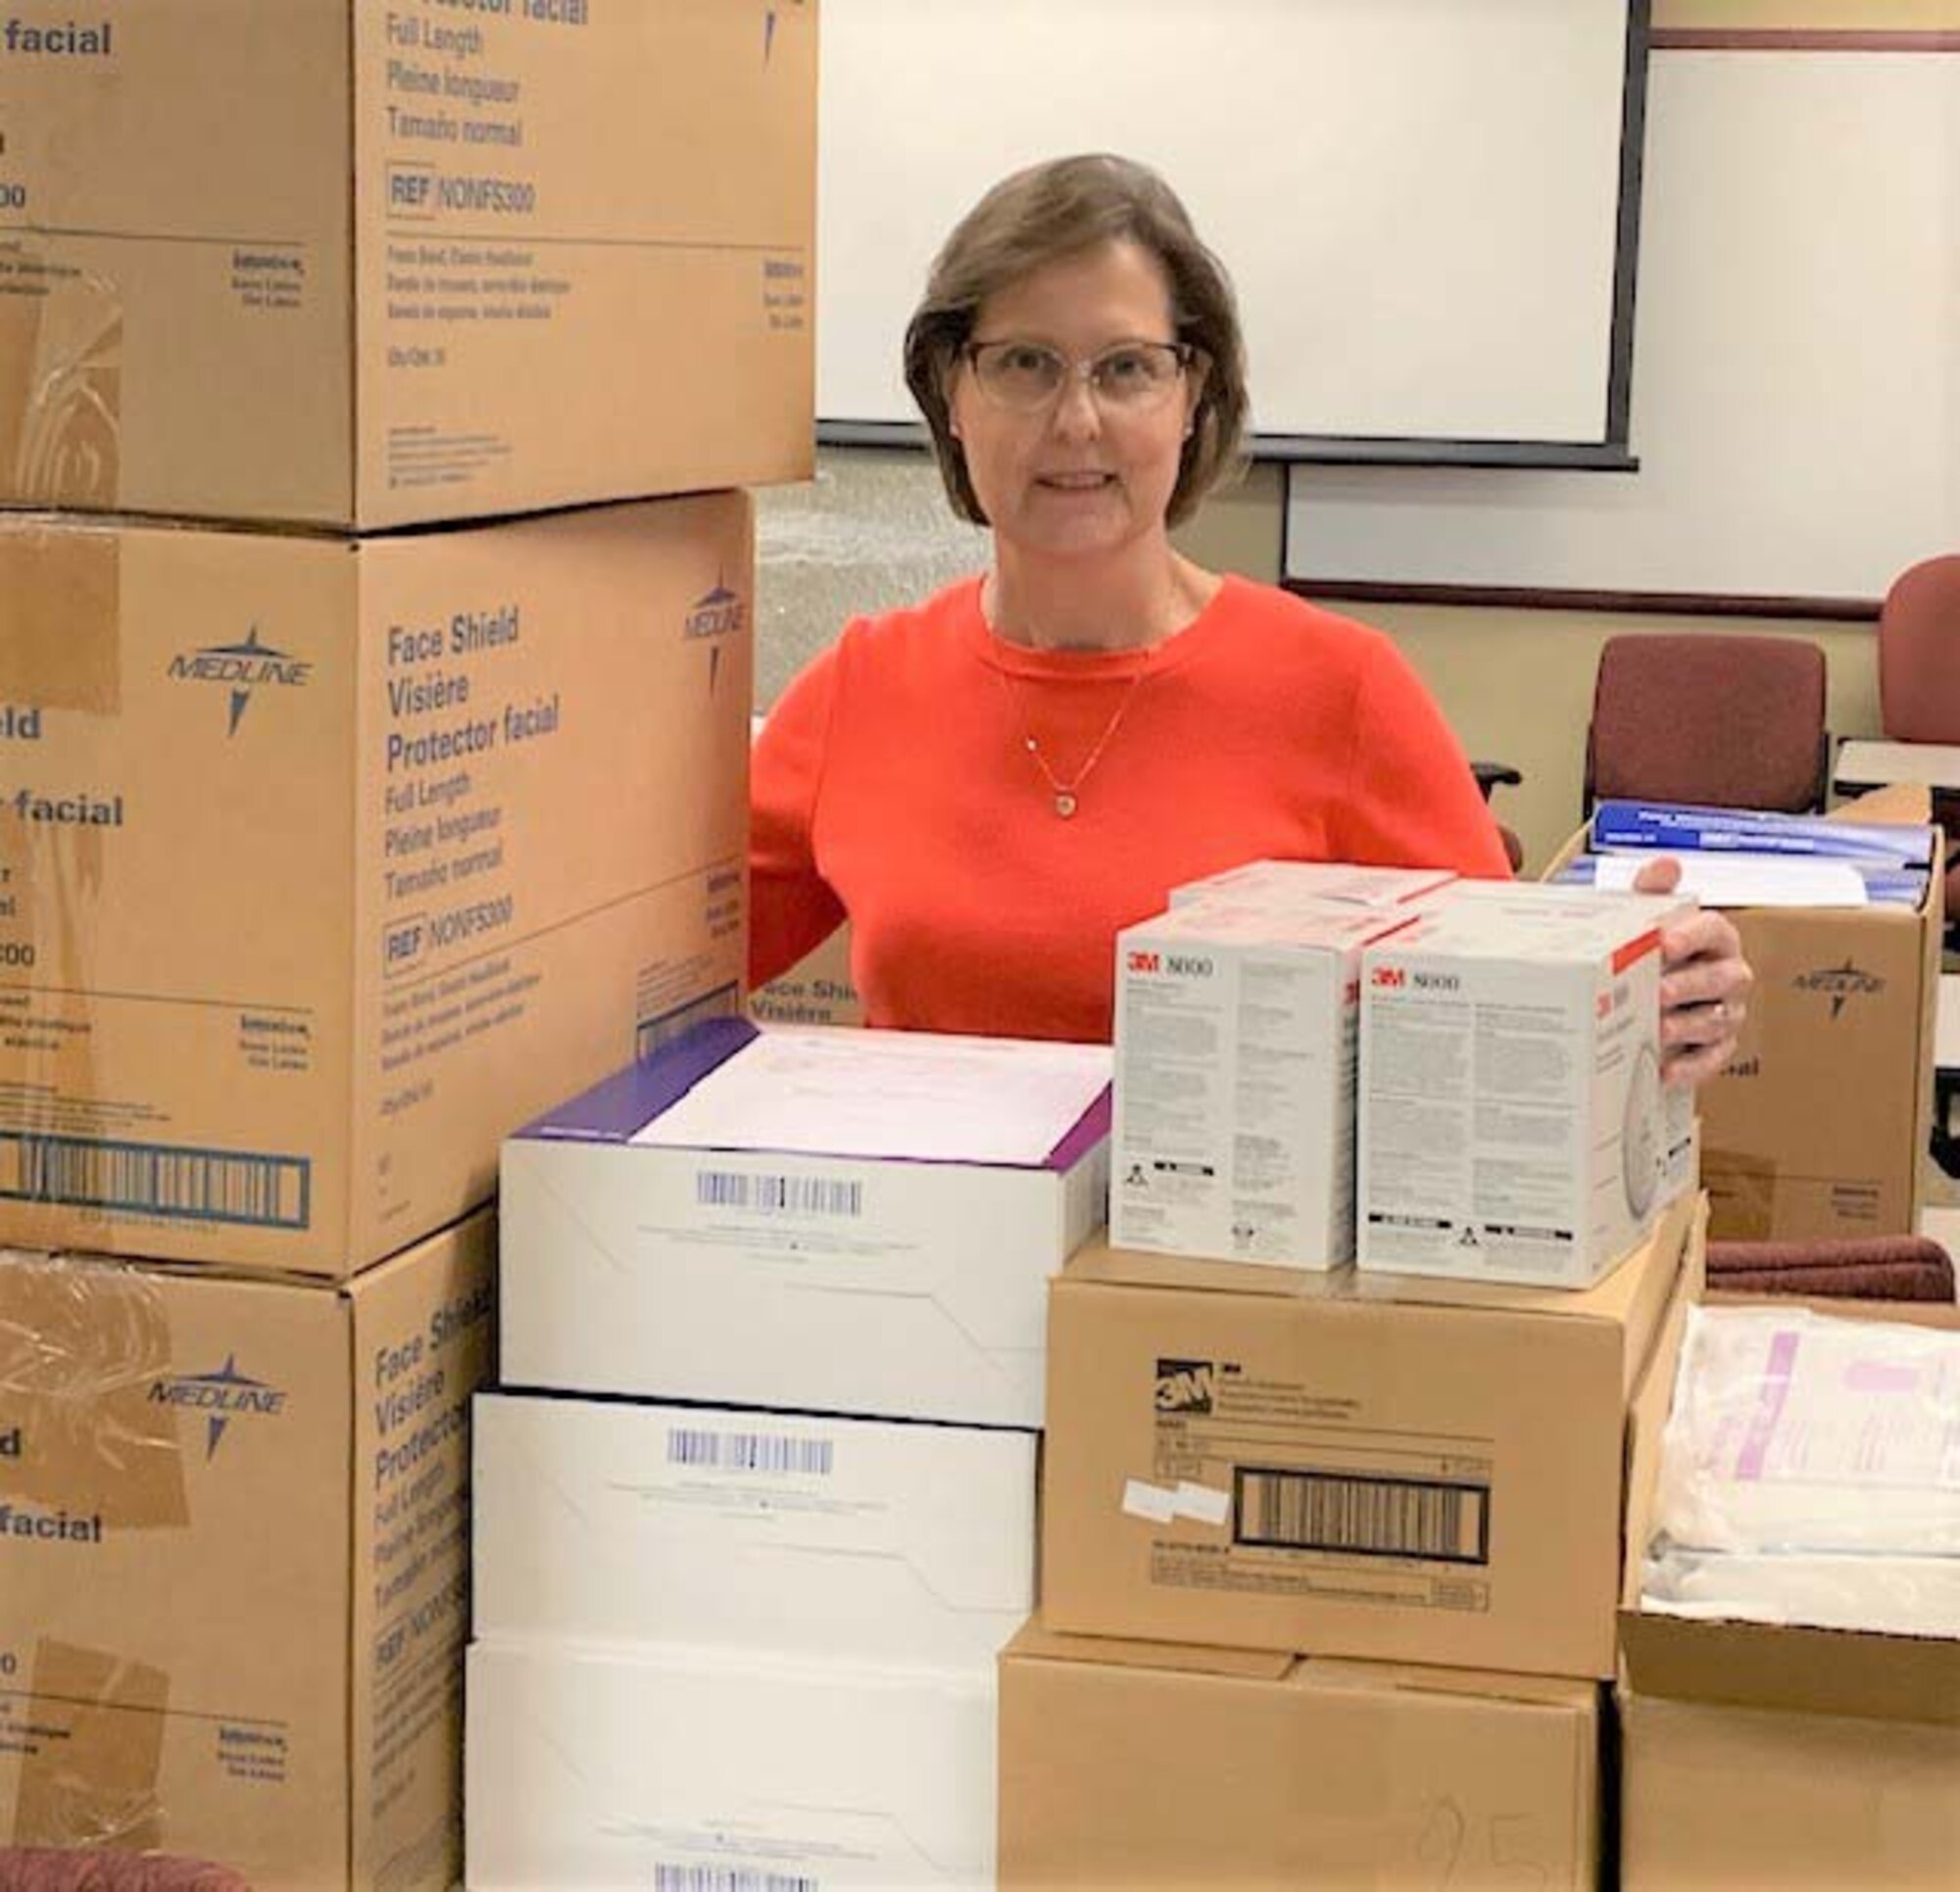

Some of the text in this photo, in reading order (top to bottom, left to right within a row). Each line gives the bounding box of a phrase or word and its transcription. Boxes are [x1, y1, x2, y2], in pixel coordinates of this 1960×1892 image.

[5, 20, 112, 55] facial
[387, 13, 482, 60] Full Length
[387, 60, 519, 106] Pleine longueur
[464, 118, 523, 147] normal
[392, 173, 429, 205] REF
[387, 606, 520, 666] Face Shield
[167, 655, 313, 687] MEDLINE
[387, 669, 469, 718] Visière
[387, 694, 560, 773] Protector facial
[15, 789, 123, 826] facial
[385, 771, 471, 816] Full Length
[385, 807, 502, 858] Pleine longueur
[452, 838, 503, 880] normal
[388, 924, 421, 963] REF
[1127, 952, 1158, 972] 3M
[763, 981, 805, 996] ace
[1372, 968, 1405, 988] 3M
[376, 1336, 423, 1387] Face
[147, 1381, 287, 1416] MEDLINE
[376, 1370, 444, 1436] Visière
[1155, 1370, 1212, 1412] 3M
[376, 1401, 466, 1491] Protecto
[0, 1505, 102, 1544] facial
